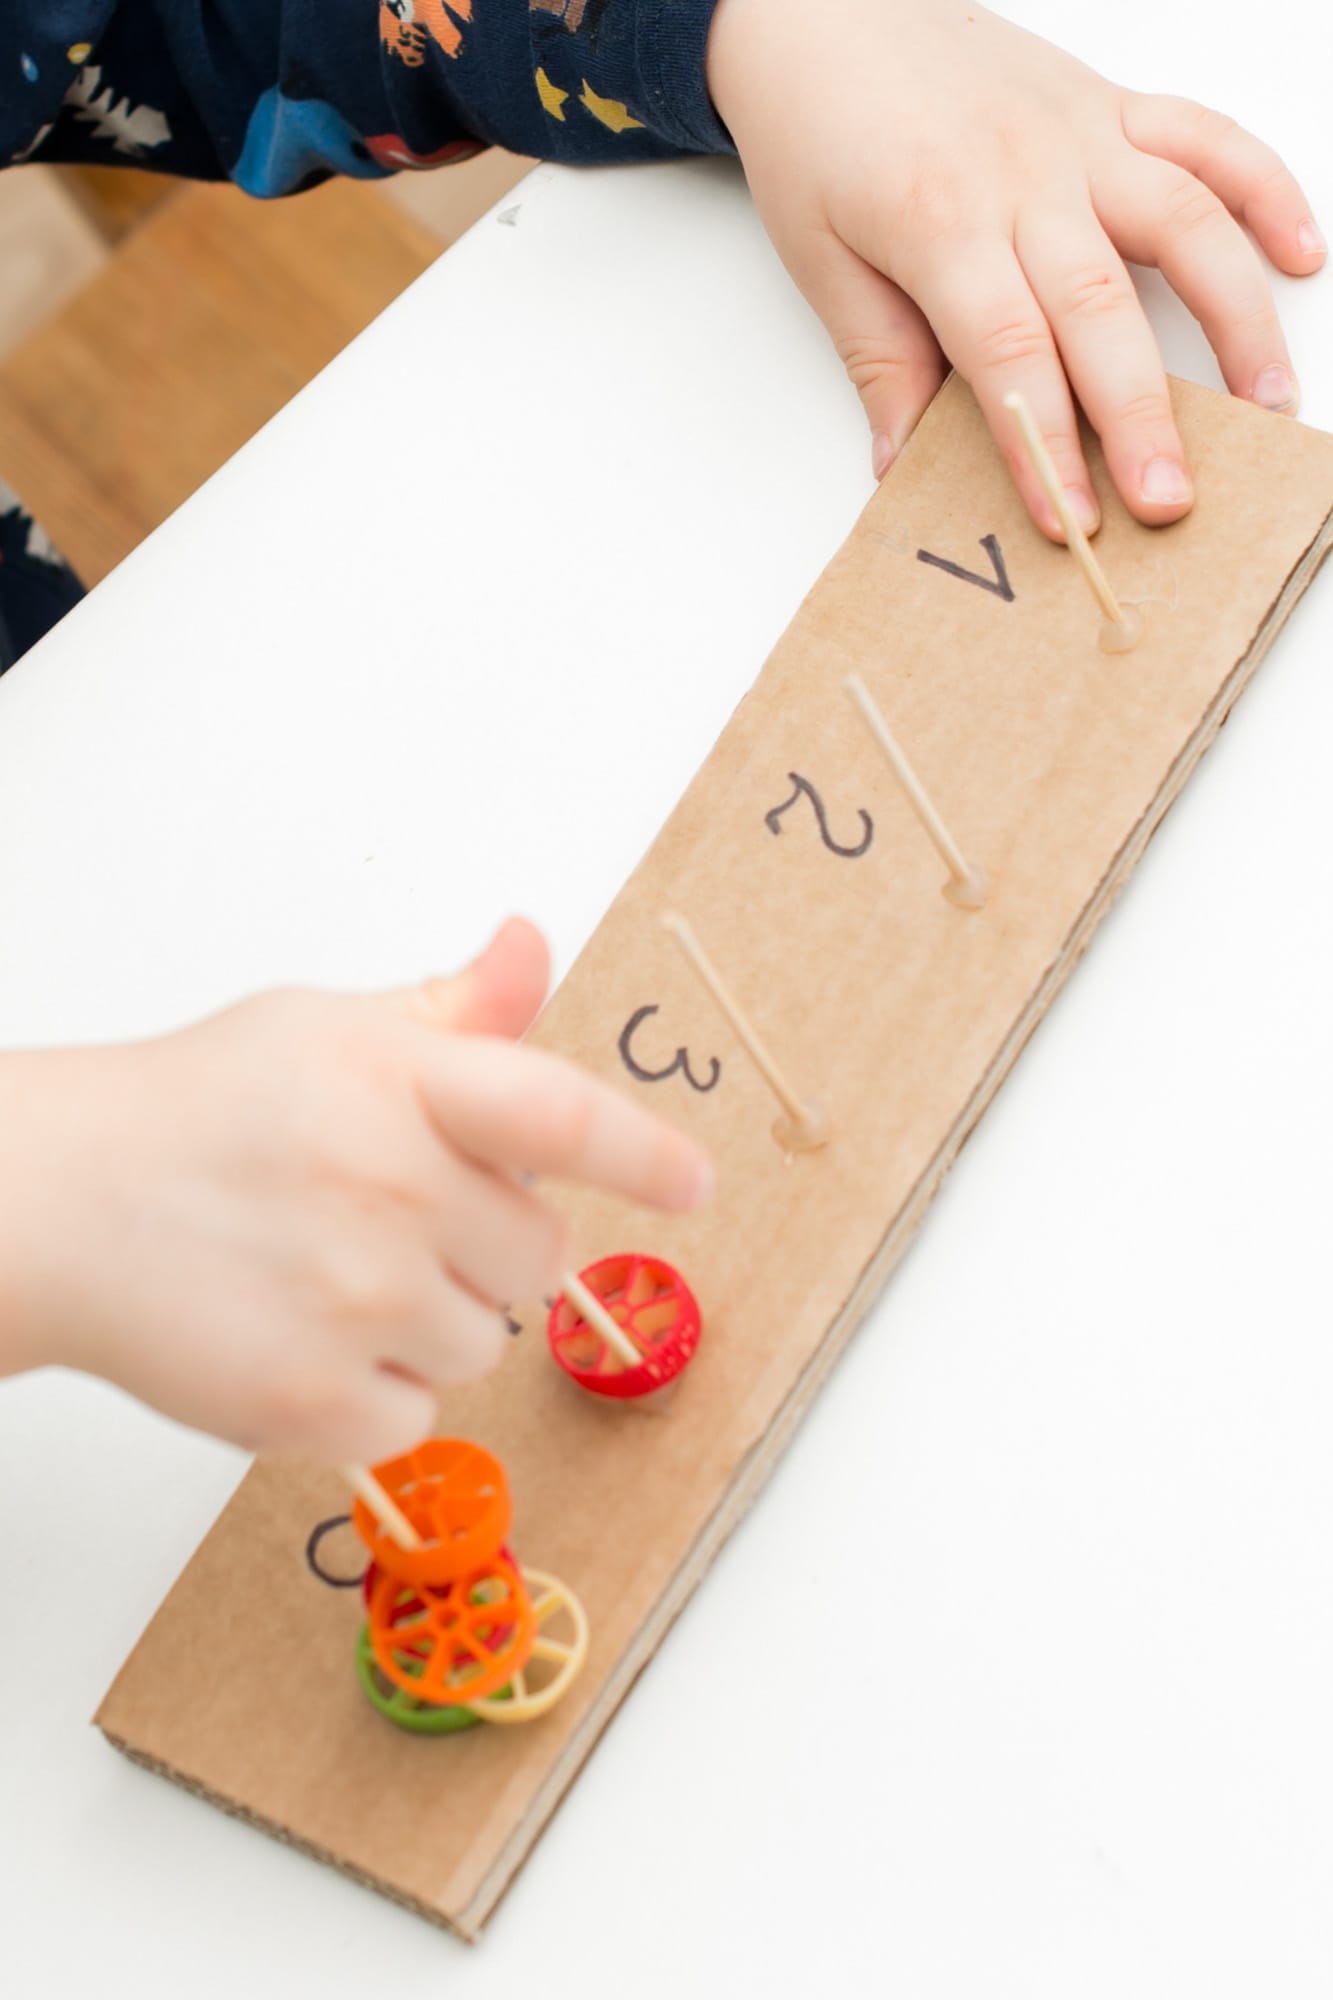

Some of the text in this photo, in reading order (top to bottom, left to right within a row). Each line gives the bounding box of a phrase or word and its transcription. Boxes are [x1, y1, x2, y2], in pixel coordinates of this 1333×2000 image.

[916, 533, 1015, 602] 1
[764, 771, 874, 859] 2
[618, 1003, 721, 1092] 3
